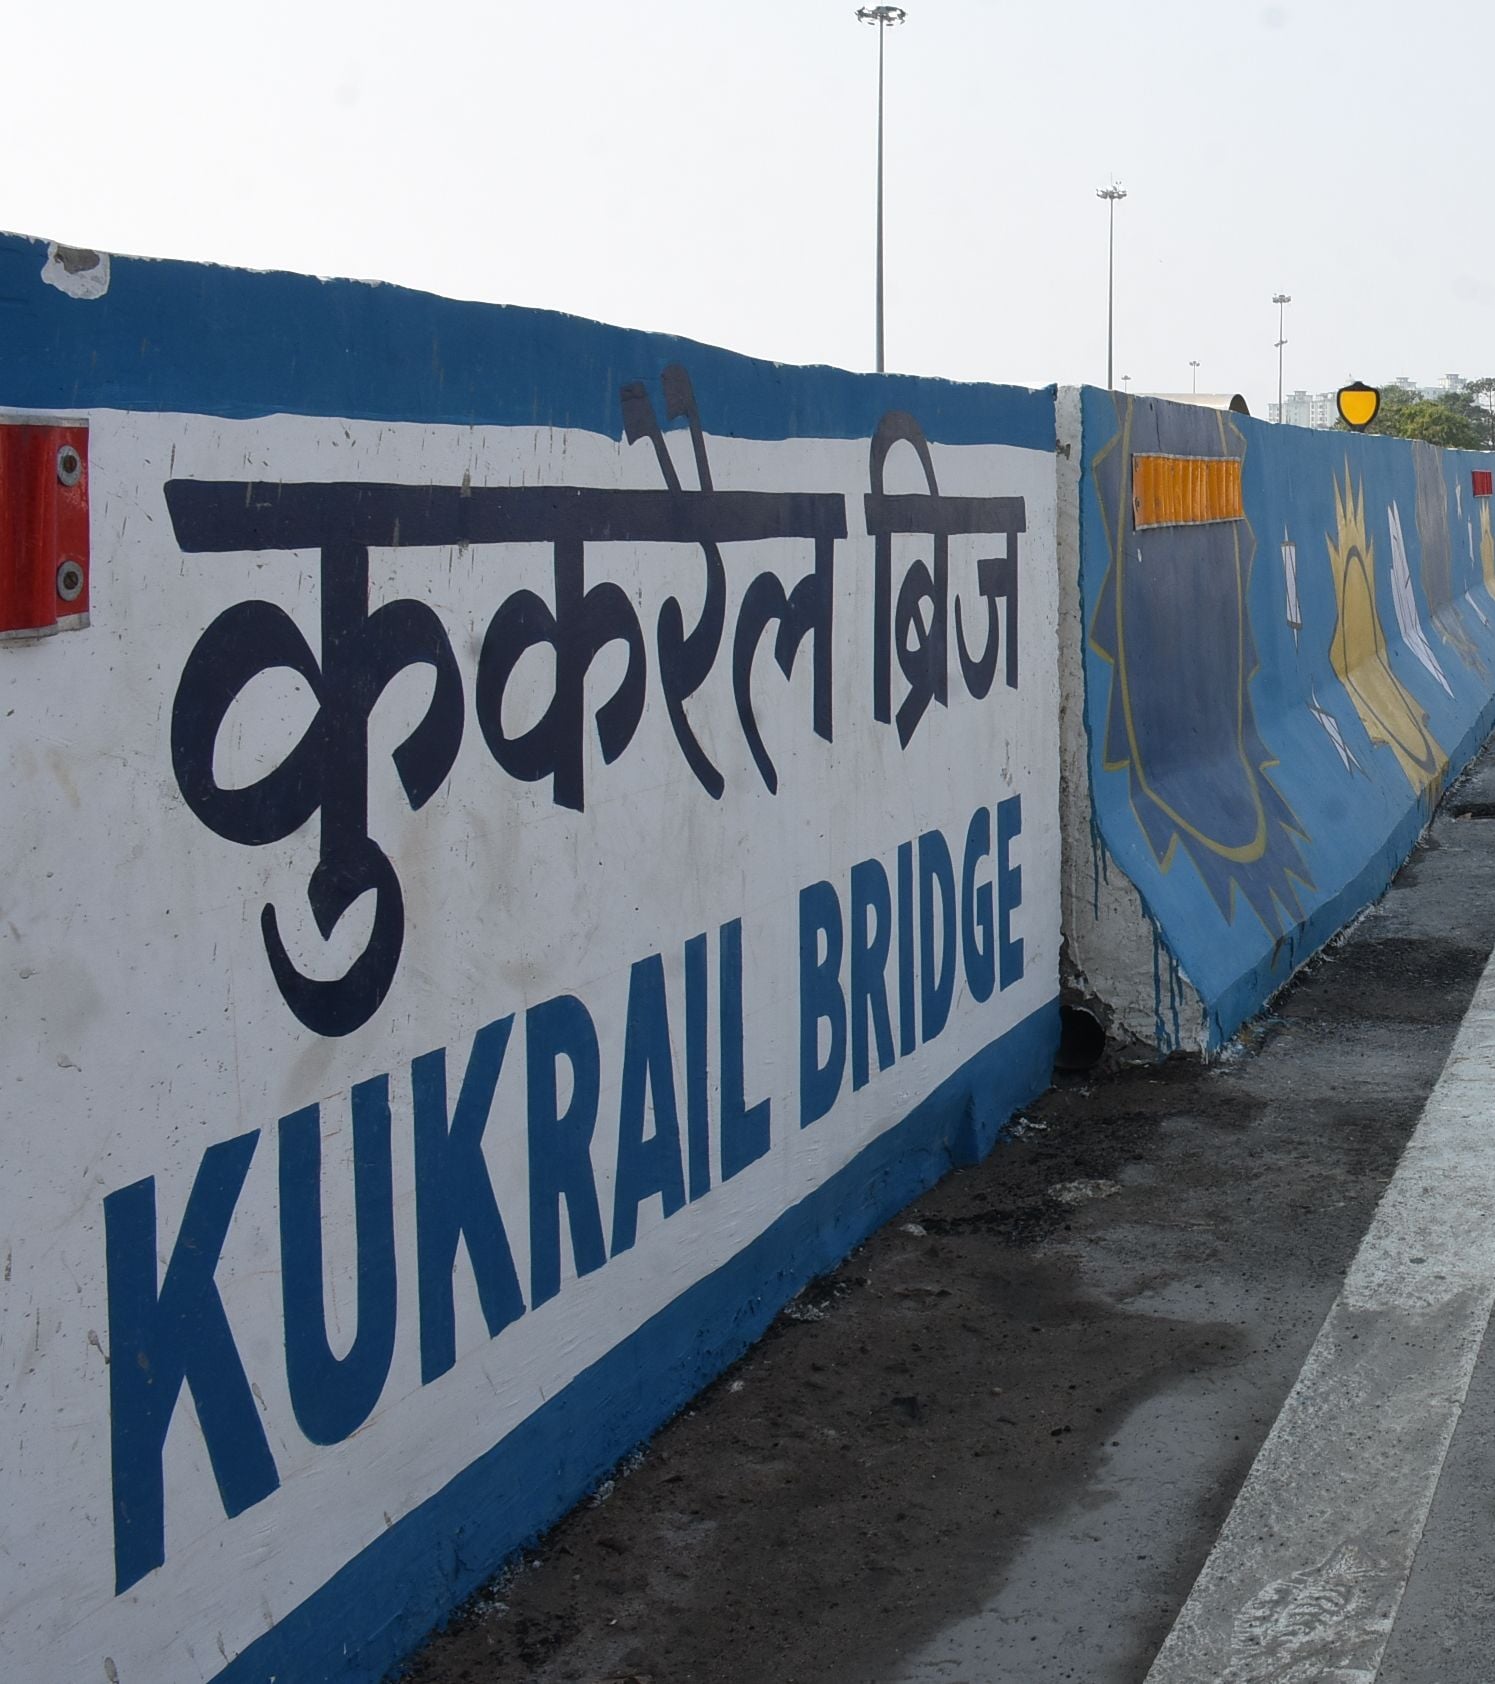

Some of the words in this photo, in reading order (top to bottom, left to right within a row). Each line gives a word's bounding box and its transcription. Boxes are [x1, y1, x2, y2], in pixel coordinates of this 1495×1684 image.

[164, 363, 848, 1038] कुकरैल
[863, 410, 1027, 751] ब्रिज
[102, 917, 771, 1597] KUKRAIL
[799, 793, 1025, 1130] BRIDGE
